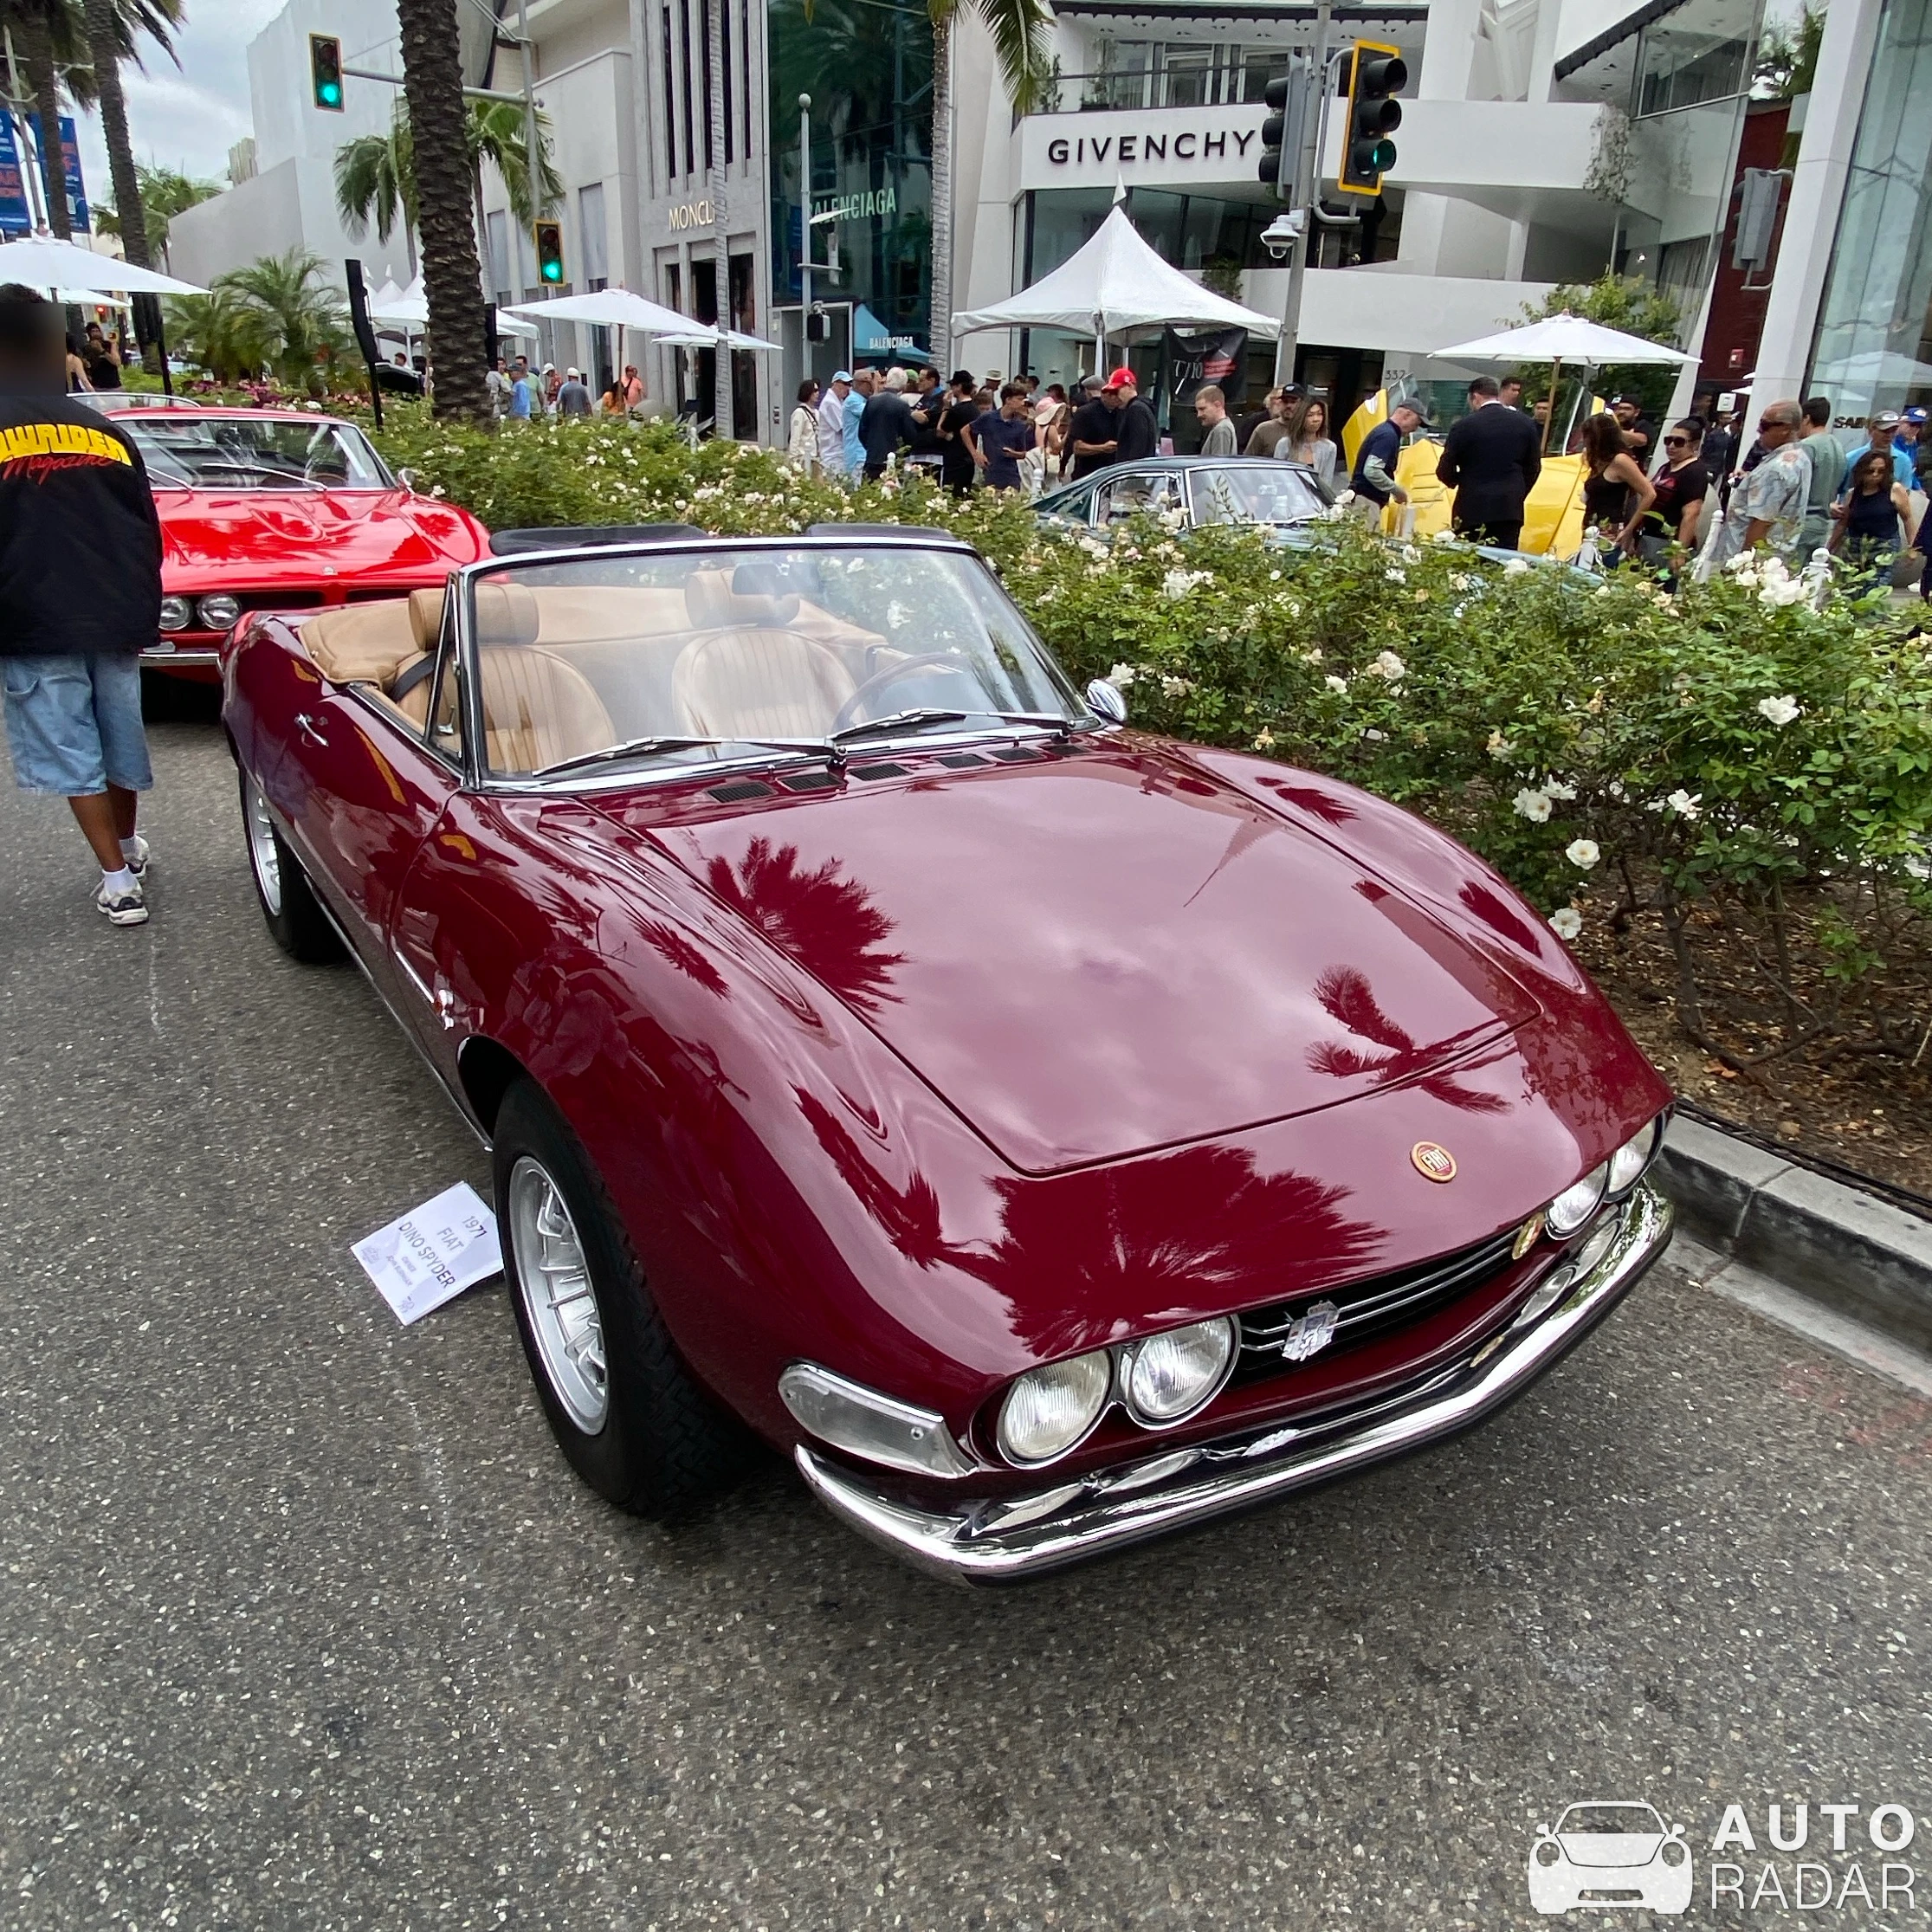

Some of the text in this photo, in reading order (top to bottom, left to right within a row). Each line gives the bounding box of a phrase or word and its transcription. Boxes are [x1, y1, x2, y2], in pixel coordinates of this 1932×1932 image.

[1048, 130, 1256, 164] GIVENCHY
[669, 200, 728, 232] MONCL
[869, 336, 914, 349] BALENCIAGA
[0, 423, 132, 466] WRIDER
[3, 455, 115, 485] Magazine
[436, 1227, 465, 1251] FIAT
[462, 1215, 488, 1239] 1971
[397, 1221, 456, 1289] DINO SPYDER
